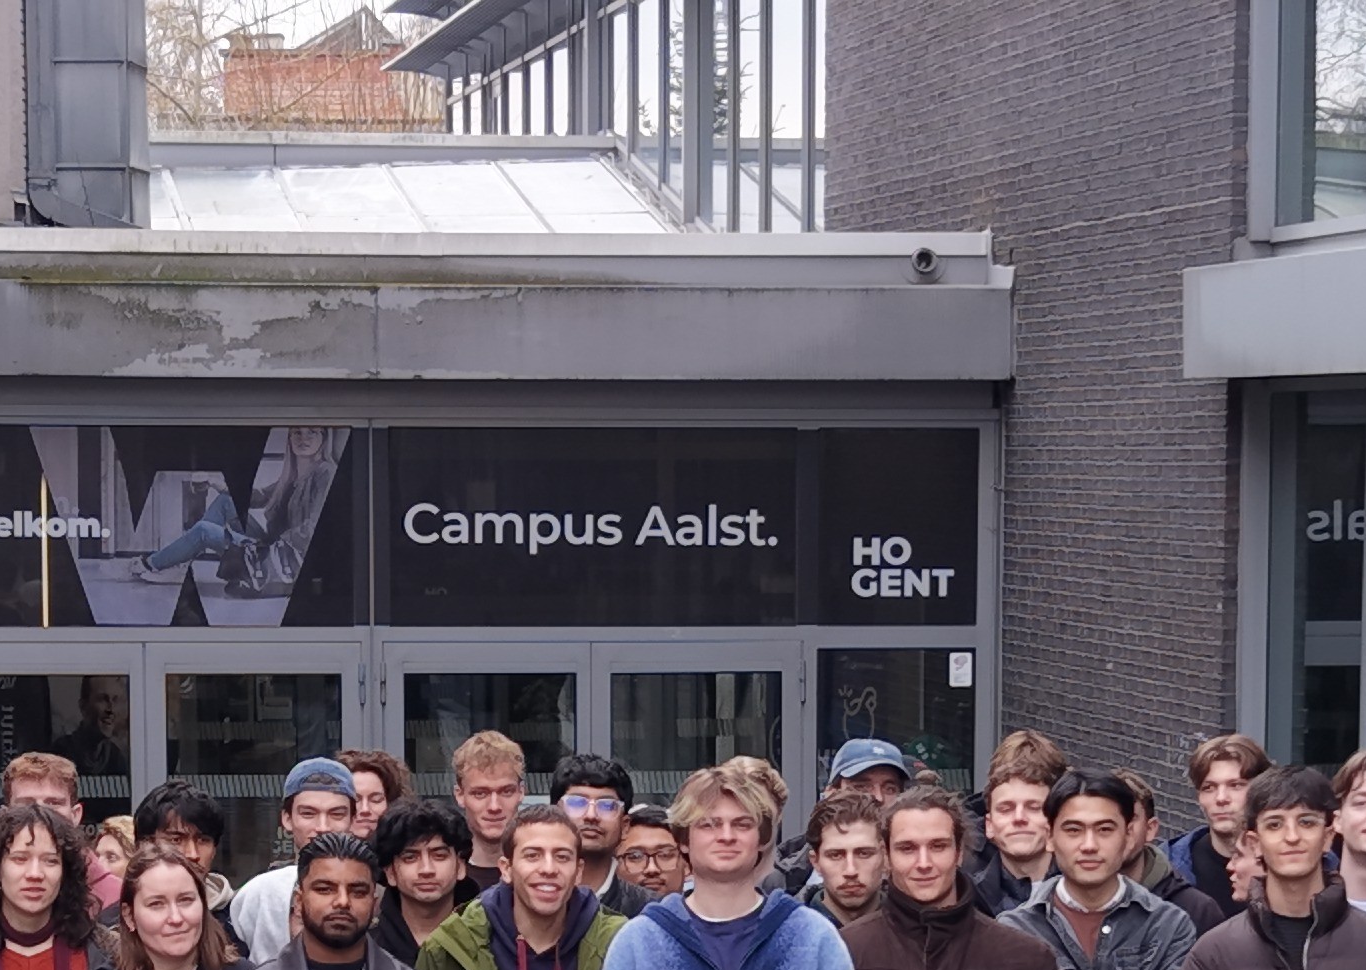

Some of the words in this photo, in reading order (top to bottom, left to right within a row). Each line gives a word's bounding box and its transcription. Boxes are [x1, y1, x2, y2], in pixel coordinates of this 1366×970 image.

[403, 502, 623, 555] Campus
[635, 503, 779, 547] Aalst.
[853, 536, 912, 566] HO
[851, 568, 955, 597] GENT
